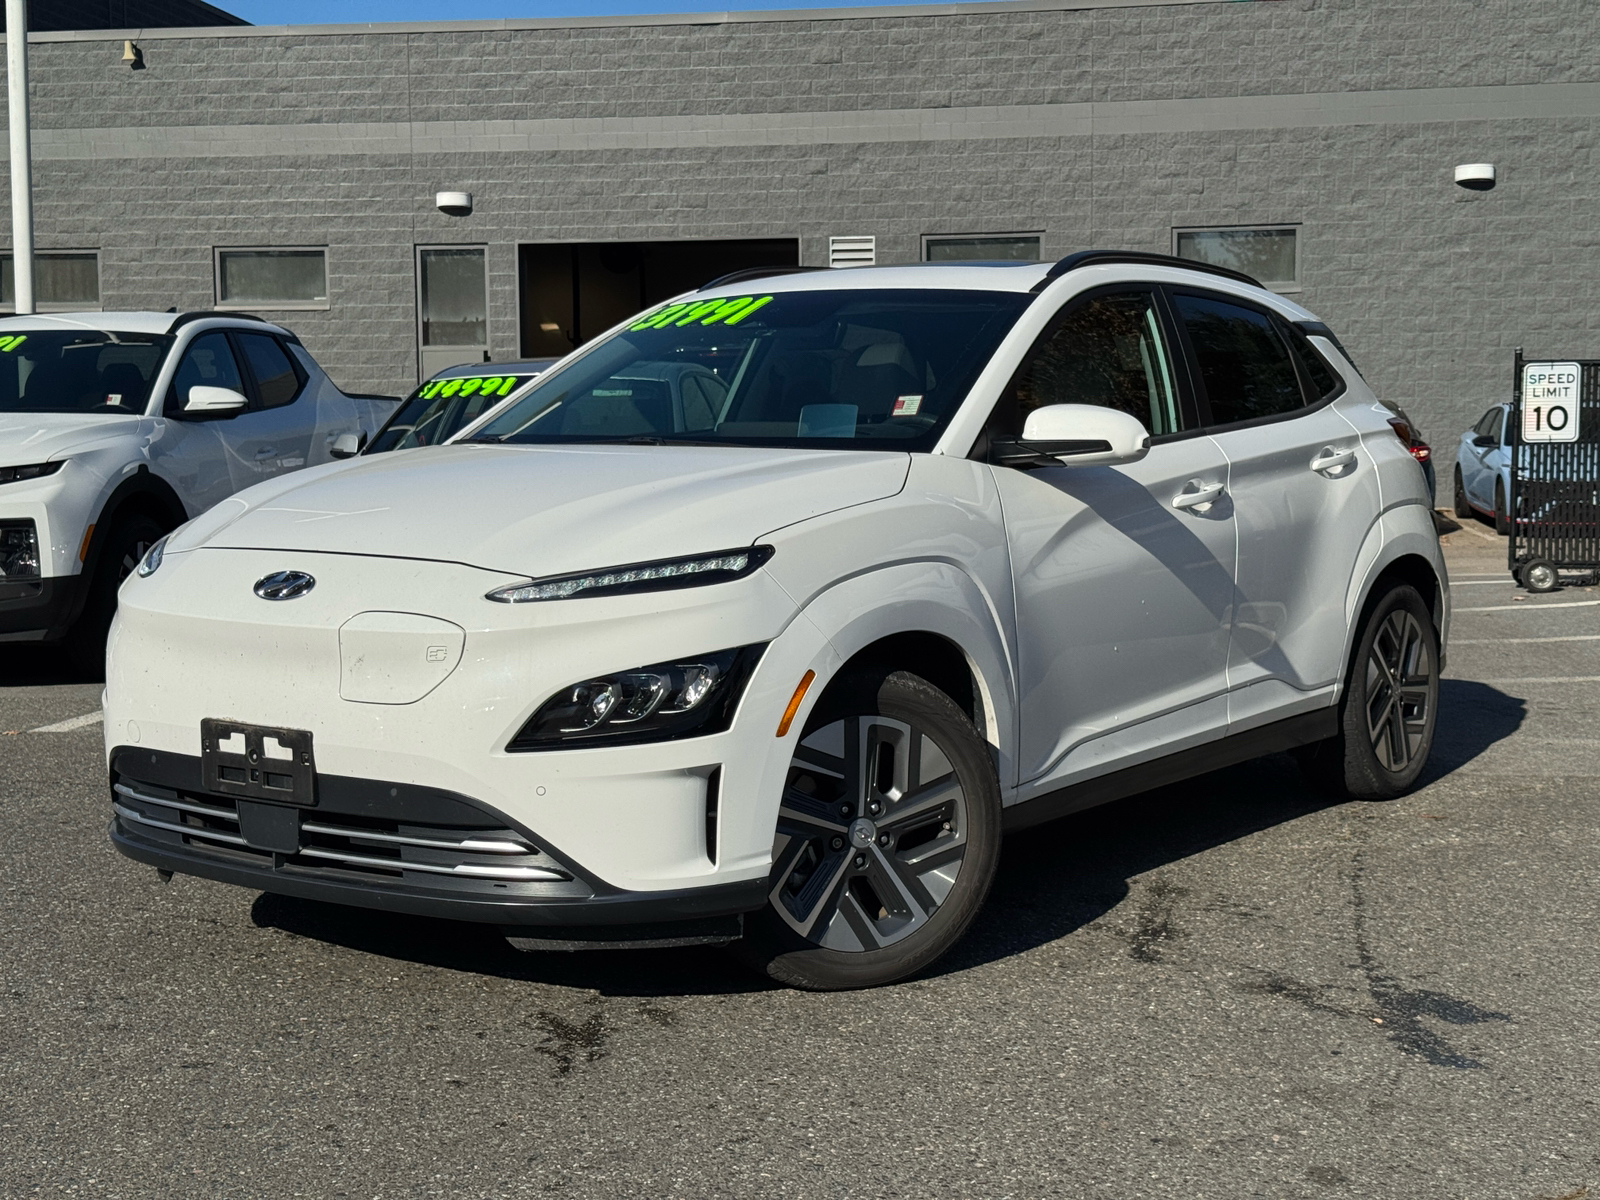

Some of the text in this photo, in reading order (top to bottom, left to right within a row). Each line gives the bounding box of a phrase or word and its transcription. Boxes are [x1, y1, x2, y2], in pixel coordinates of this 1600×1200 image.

[1529, 373, 1576, 384] SPEED
[418, 376, 518, 399] $14991
[1533, 387, 1571, 398] LIMIT
[1533, 405, 1569, 431] 10
